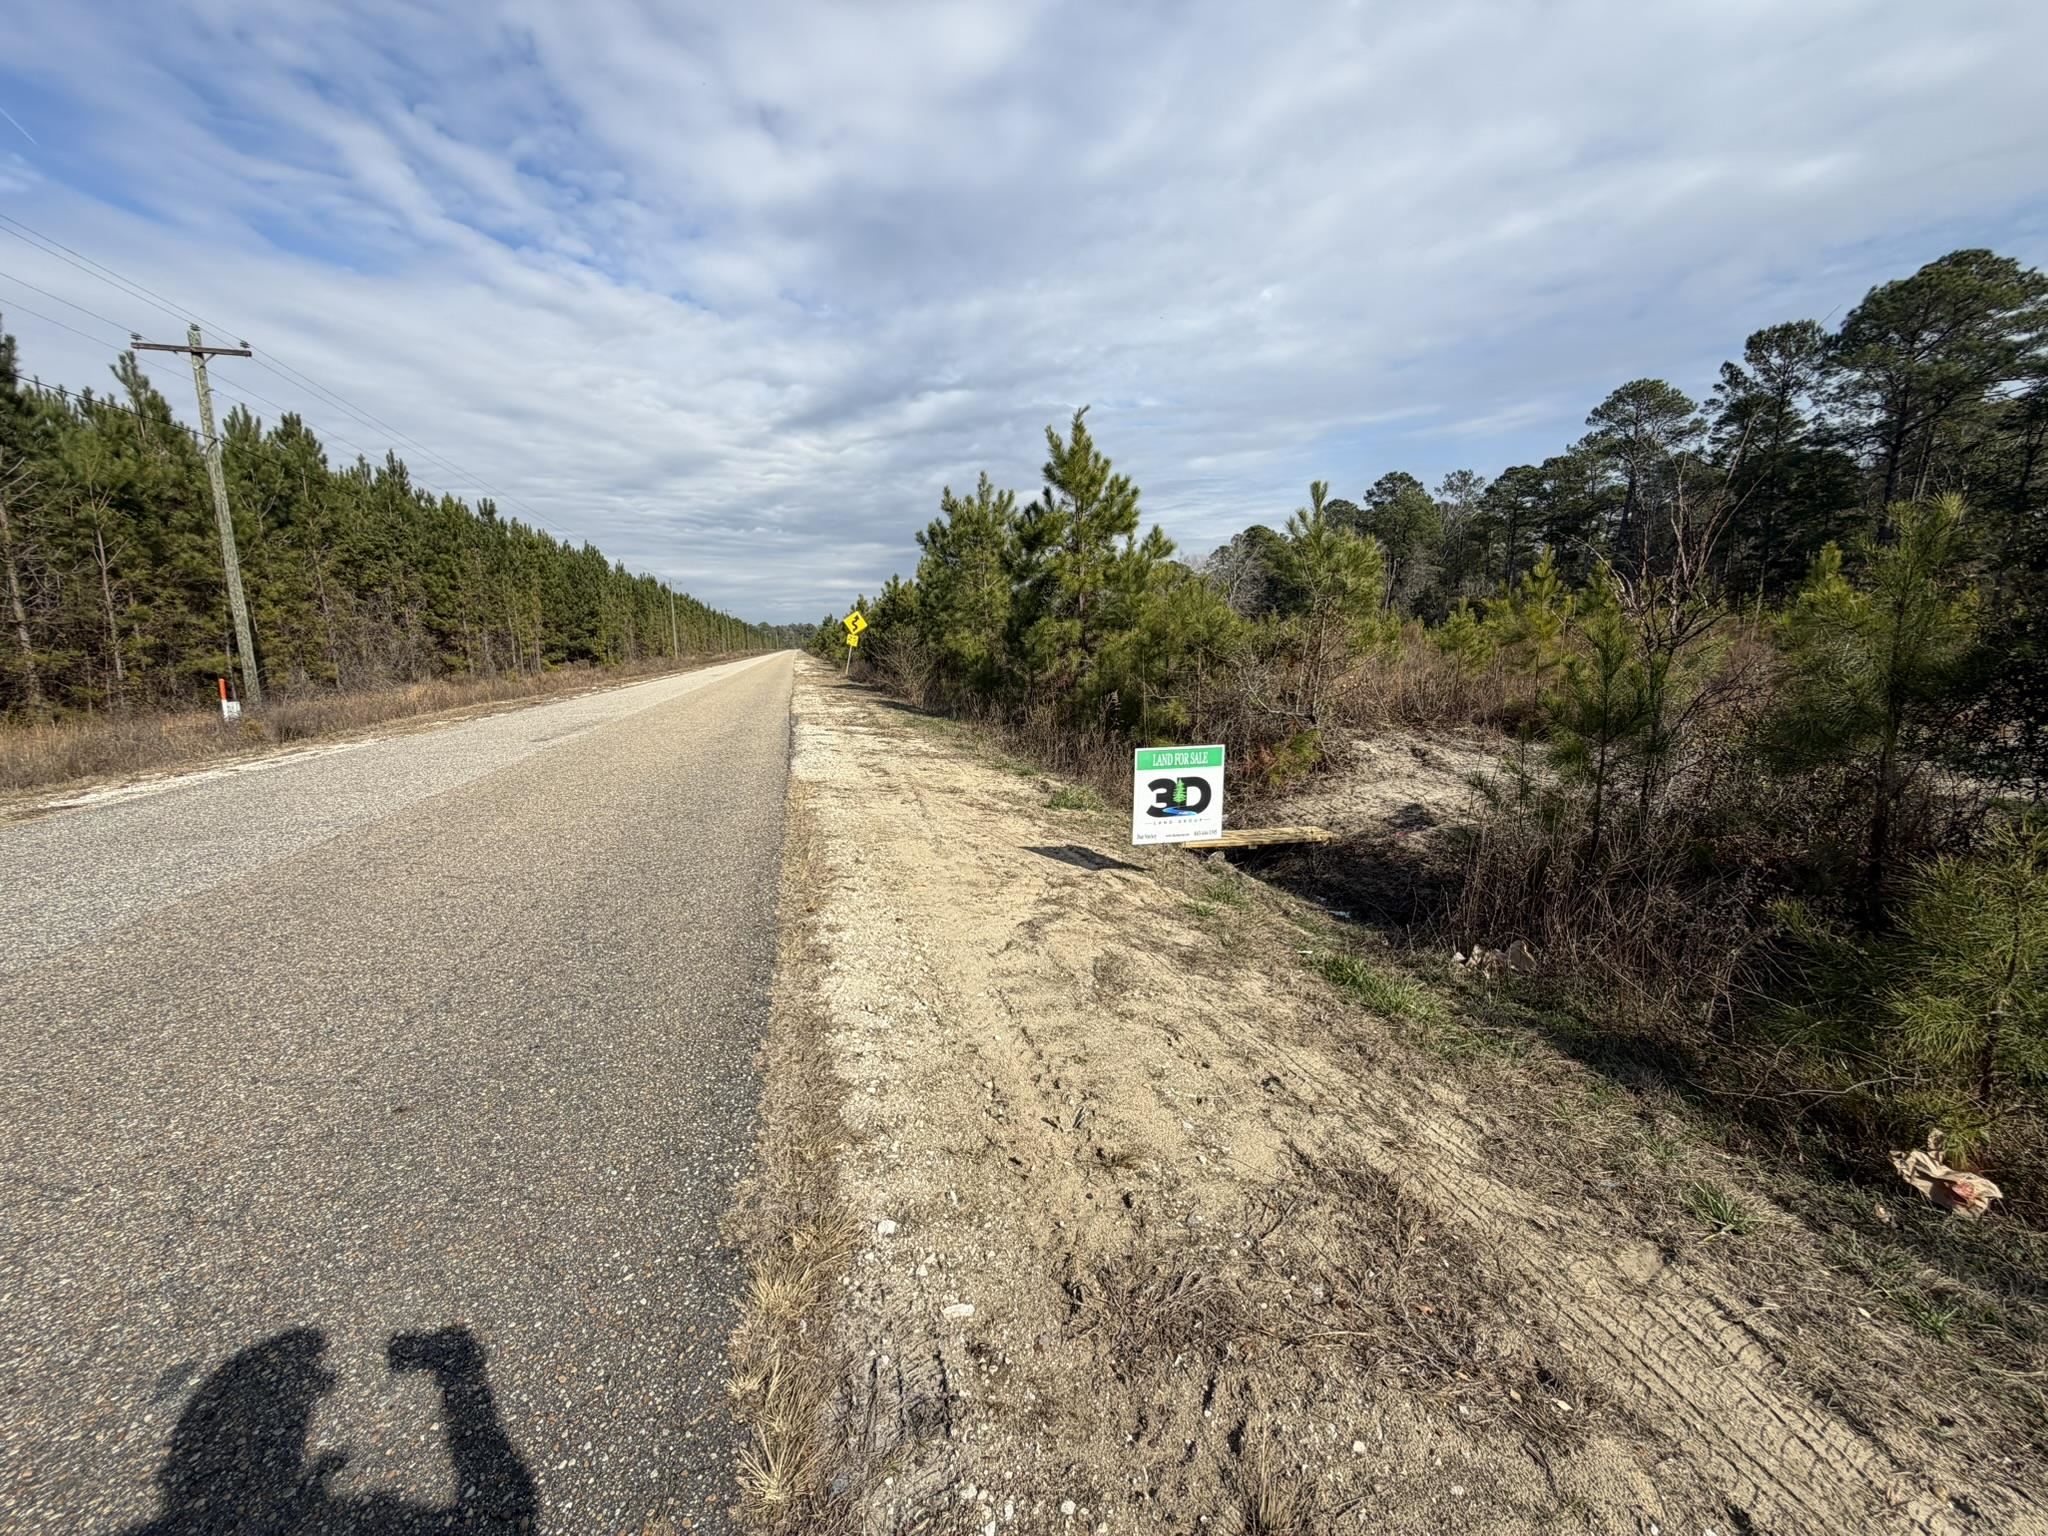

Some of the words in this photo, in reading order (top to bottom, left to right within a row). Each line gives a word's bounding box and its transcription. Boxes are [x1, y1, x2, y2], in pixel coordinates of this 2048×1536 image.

[1152, 753, 1173, 767] LAND
[1174, 752, 1190, 765] FOR
[1190, 751, 1209, 764] SALE
[1146, 776, 1212, 818] 3D
